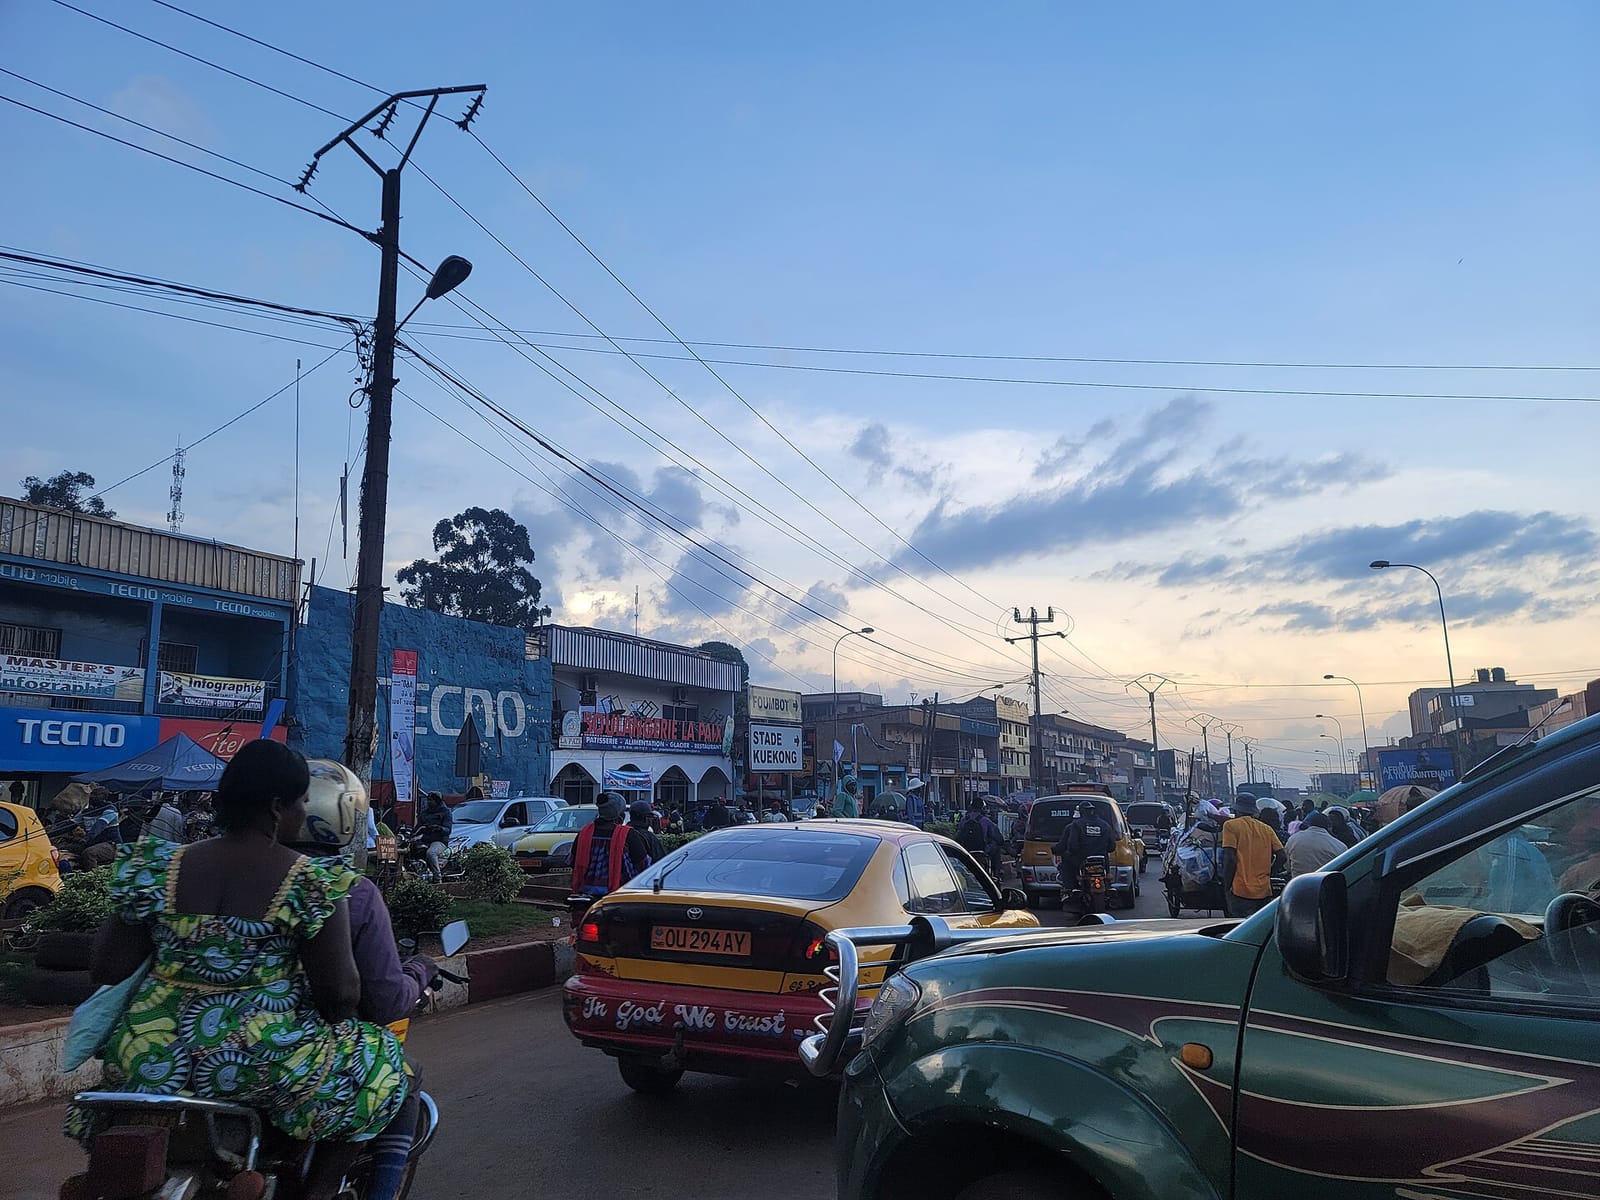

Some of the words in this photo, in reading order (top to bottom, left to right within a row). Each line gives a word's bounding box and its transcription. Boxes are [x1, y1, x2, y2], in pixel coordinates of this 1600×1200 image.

[107, 583, 158, 600] TECNO
[213, 600, 251, 615] TECNO
[6, 656, 115, 674] MASTER'S
[0, 676, 114, 696] nfographie
[189, 678, 262, 693] Infographie
[17, 718, 126, 748] TECNO
[682, 720, 695, 741] LA
[698, 722, 722, 743] PAIX
[753, 731, 782, 746] STADE
[209, 737, 245, 754] itel
[625, 738, 665, 748] ALIMENTATION
[753, 749, 797, 764] KUEKONG
[127, 763, 161, 773] TECNO
[184, 763, 224, 772] TECNO
[1383, 765, 1417, 774] AFRIQUE
[1407, 769, 1455, 780] MAINTENANT
[582, 996, 607, 1019] In
[616, 1000, 666, 1030] God
[674, 1005, 716, 1030] We
